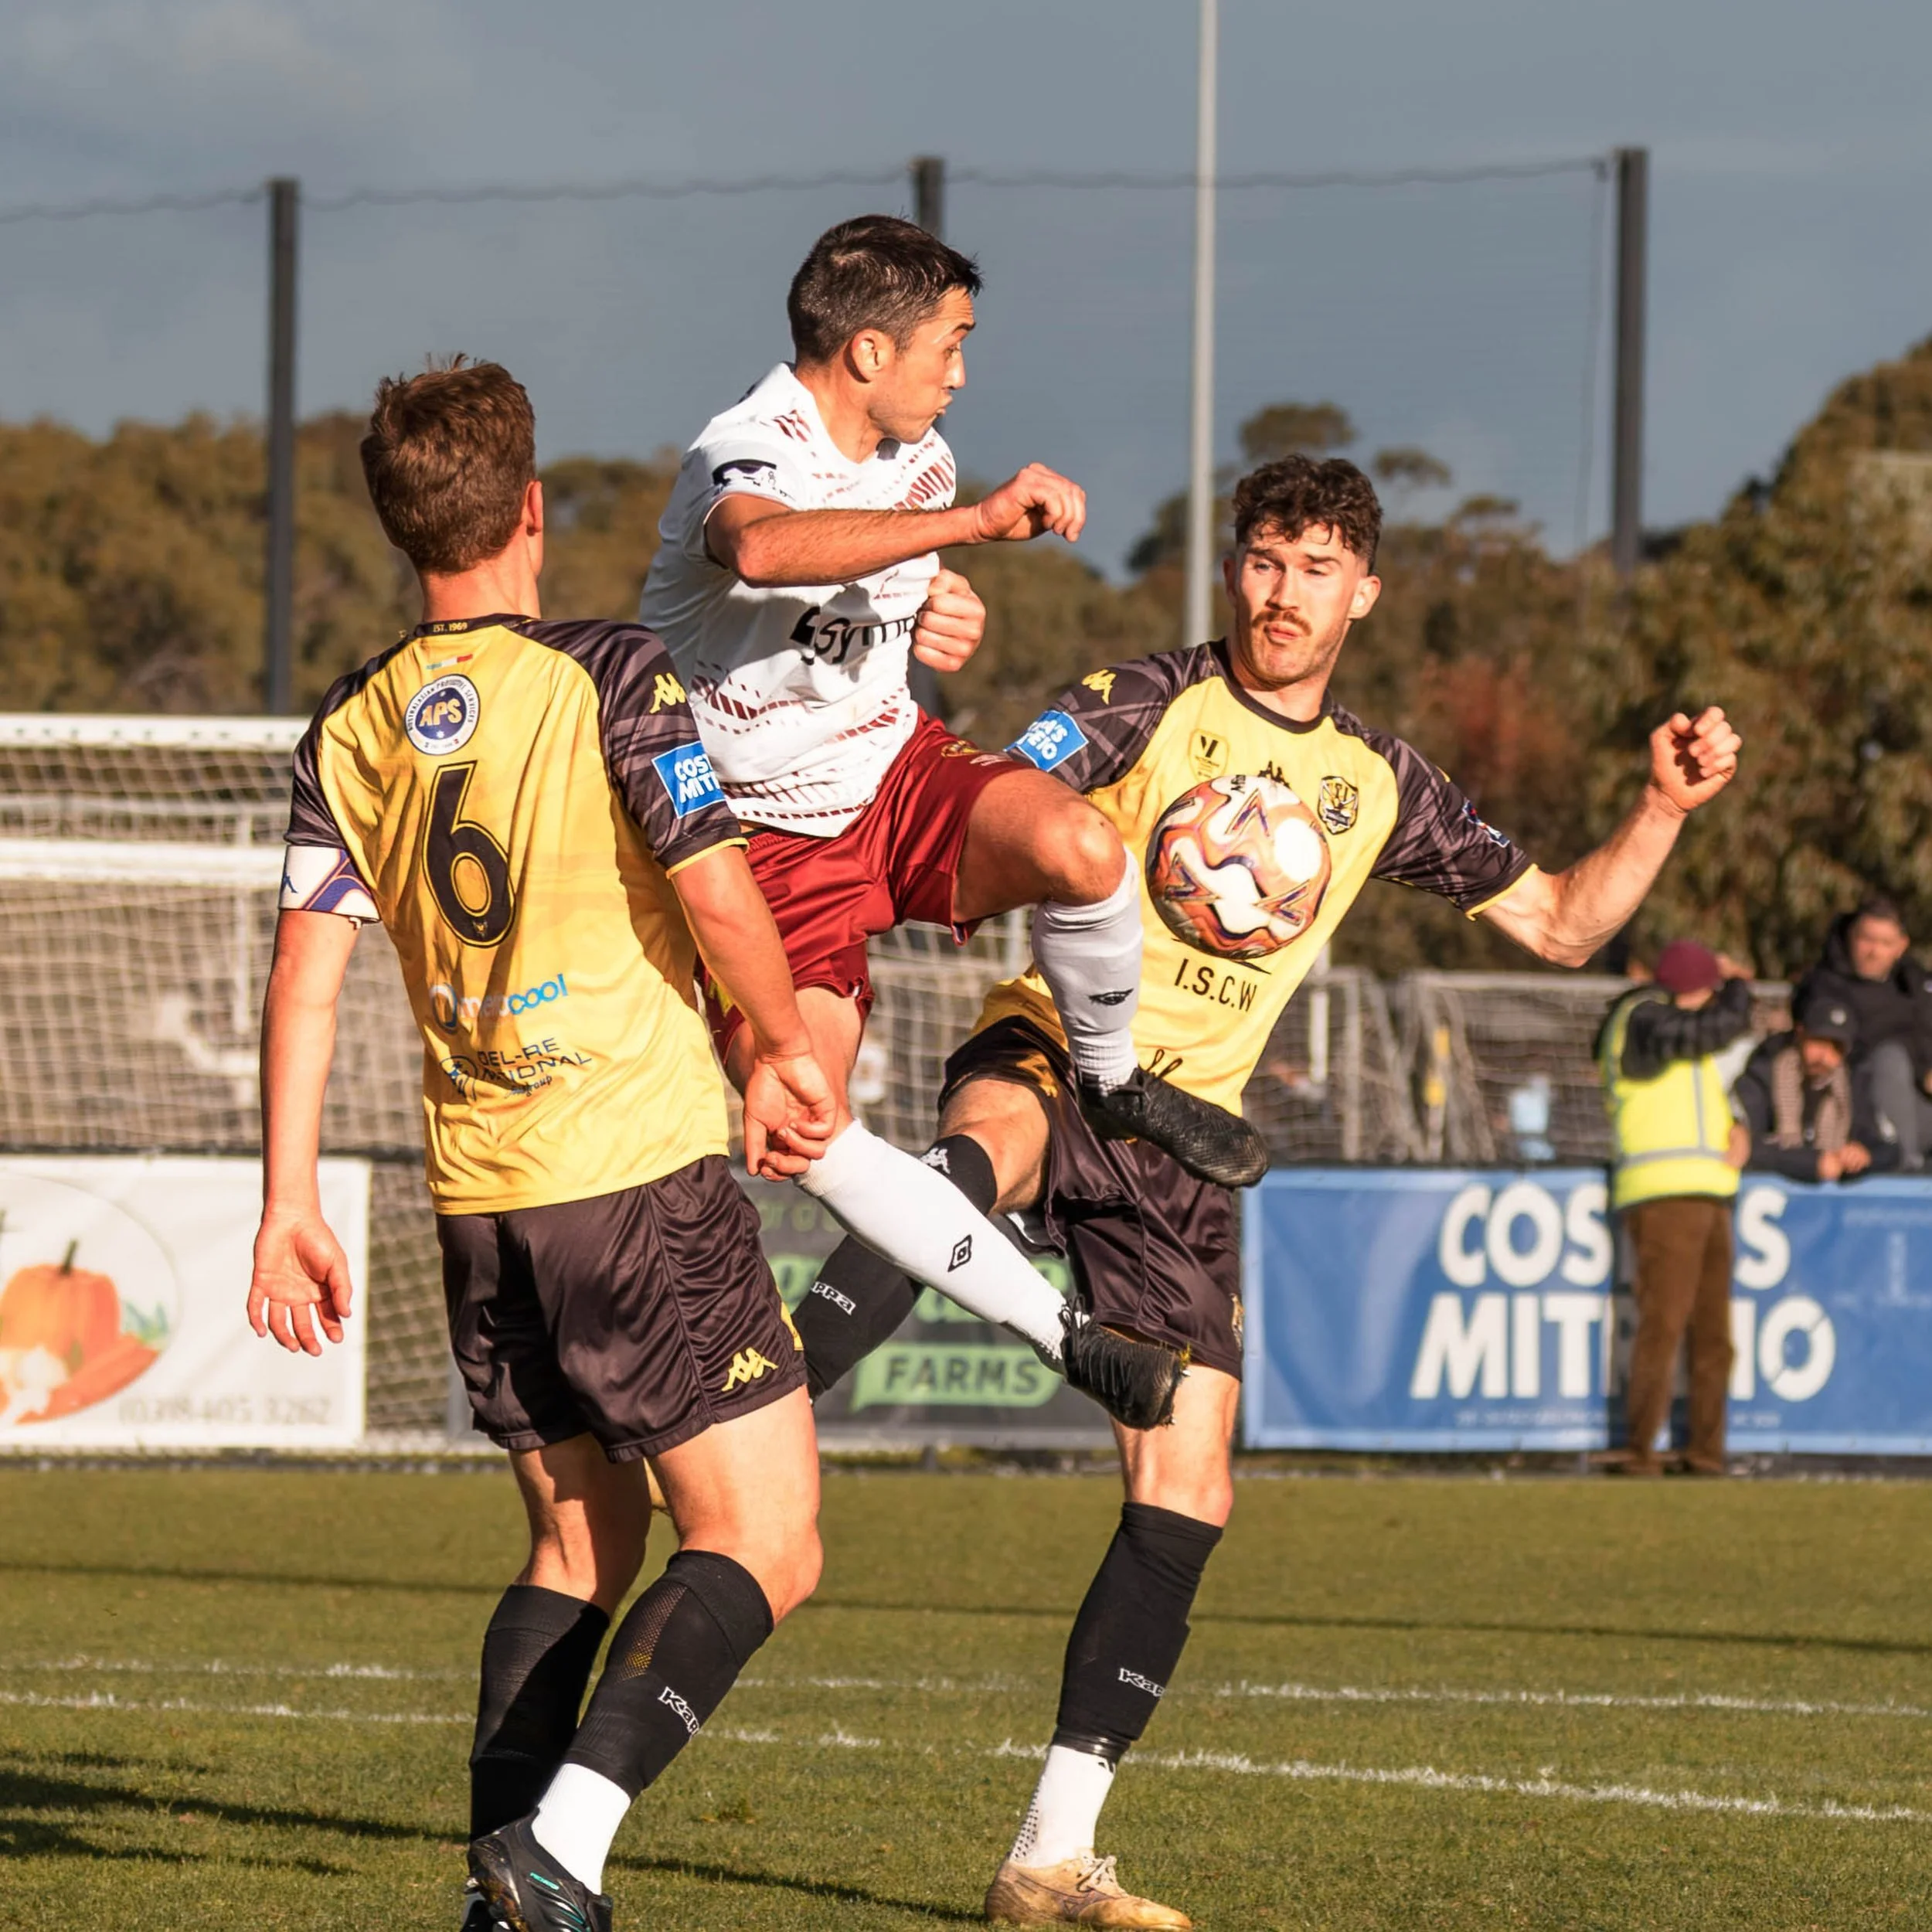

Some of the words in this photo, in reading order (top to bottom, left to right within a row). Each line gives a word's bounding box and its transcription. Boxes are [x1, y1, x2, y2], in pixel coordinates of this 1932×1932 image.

[419, 698, 463, 727] APS
[422, 760, 516, 948] 6
[1174, 957, 1258, 1012] I.S.C.W
[477, 1037, 562, 1067] DEL-RE
[481, 1052, 593, 1083] NIONAL
[886, 1355, 1040, 1396] FARMS
